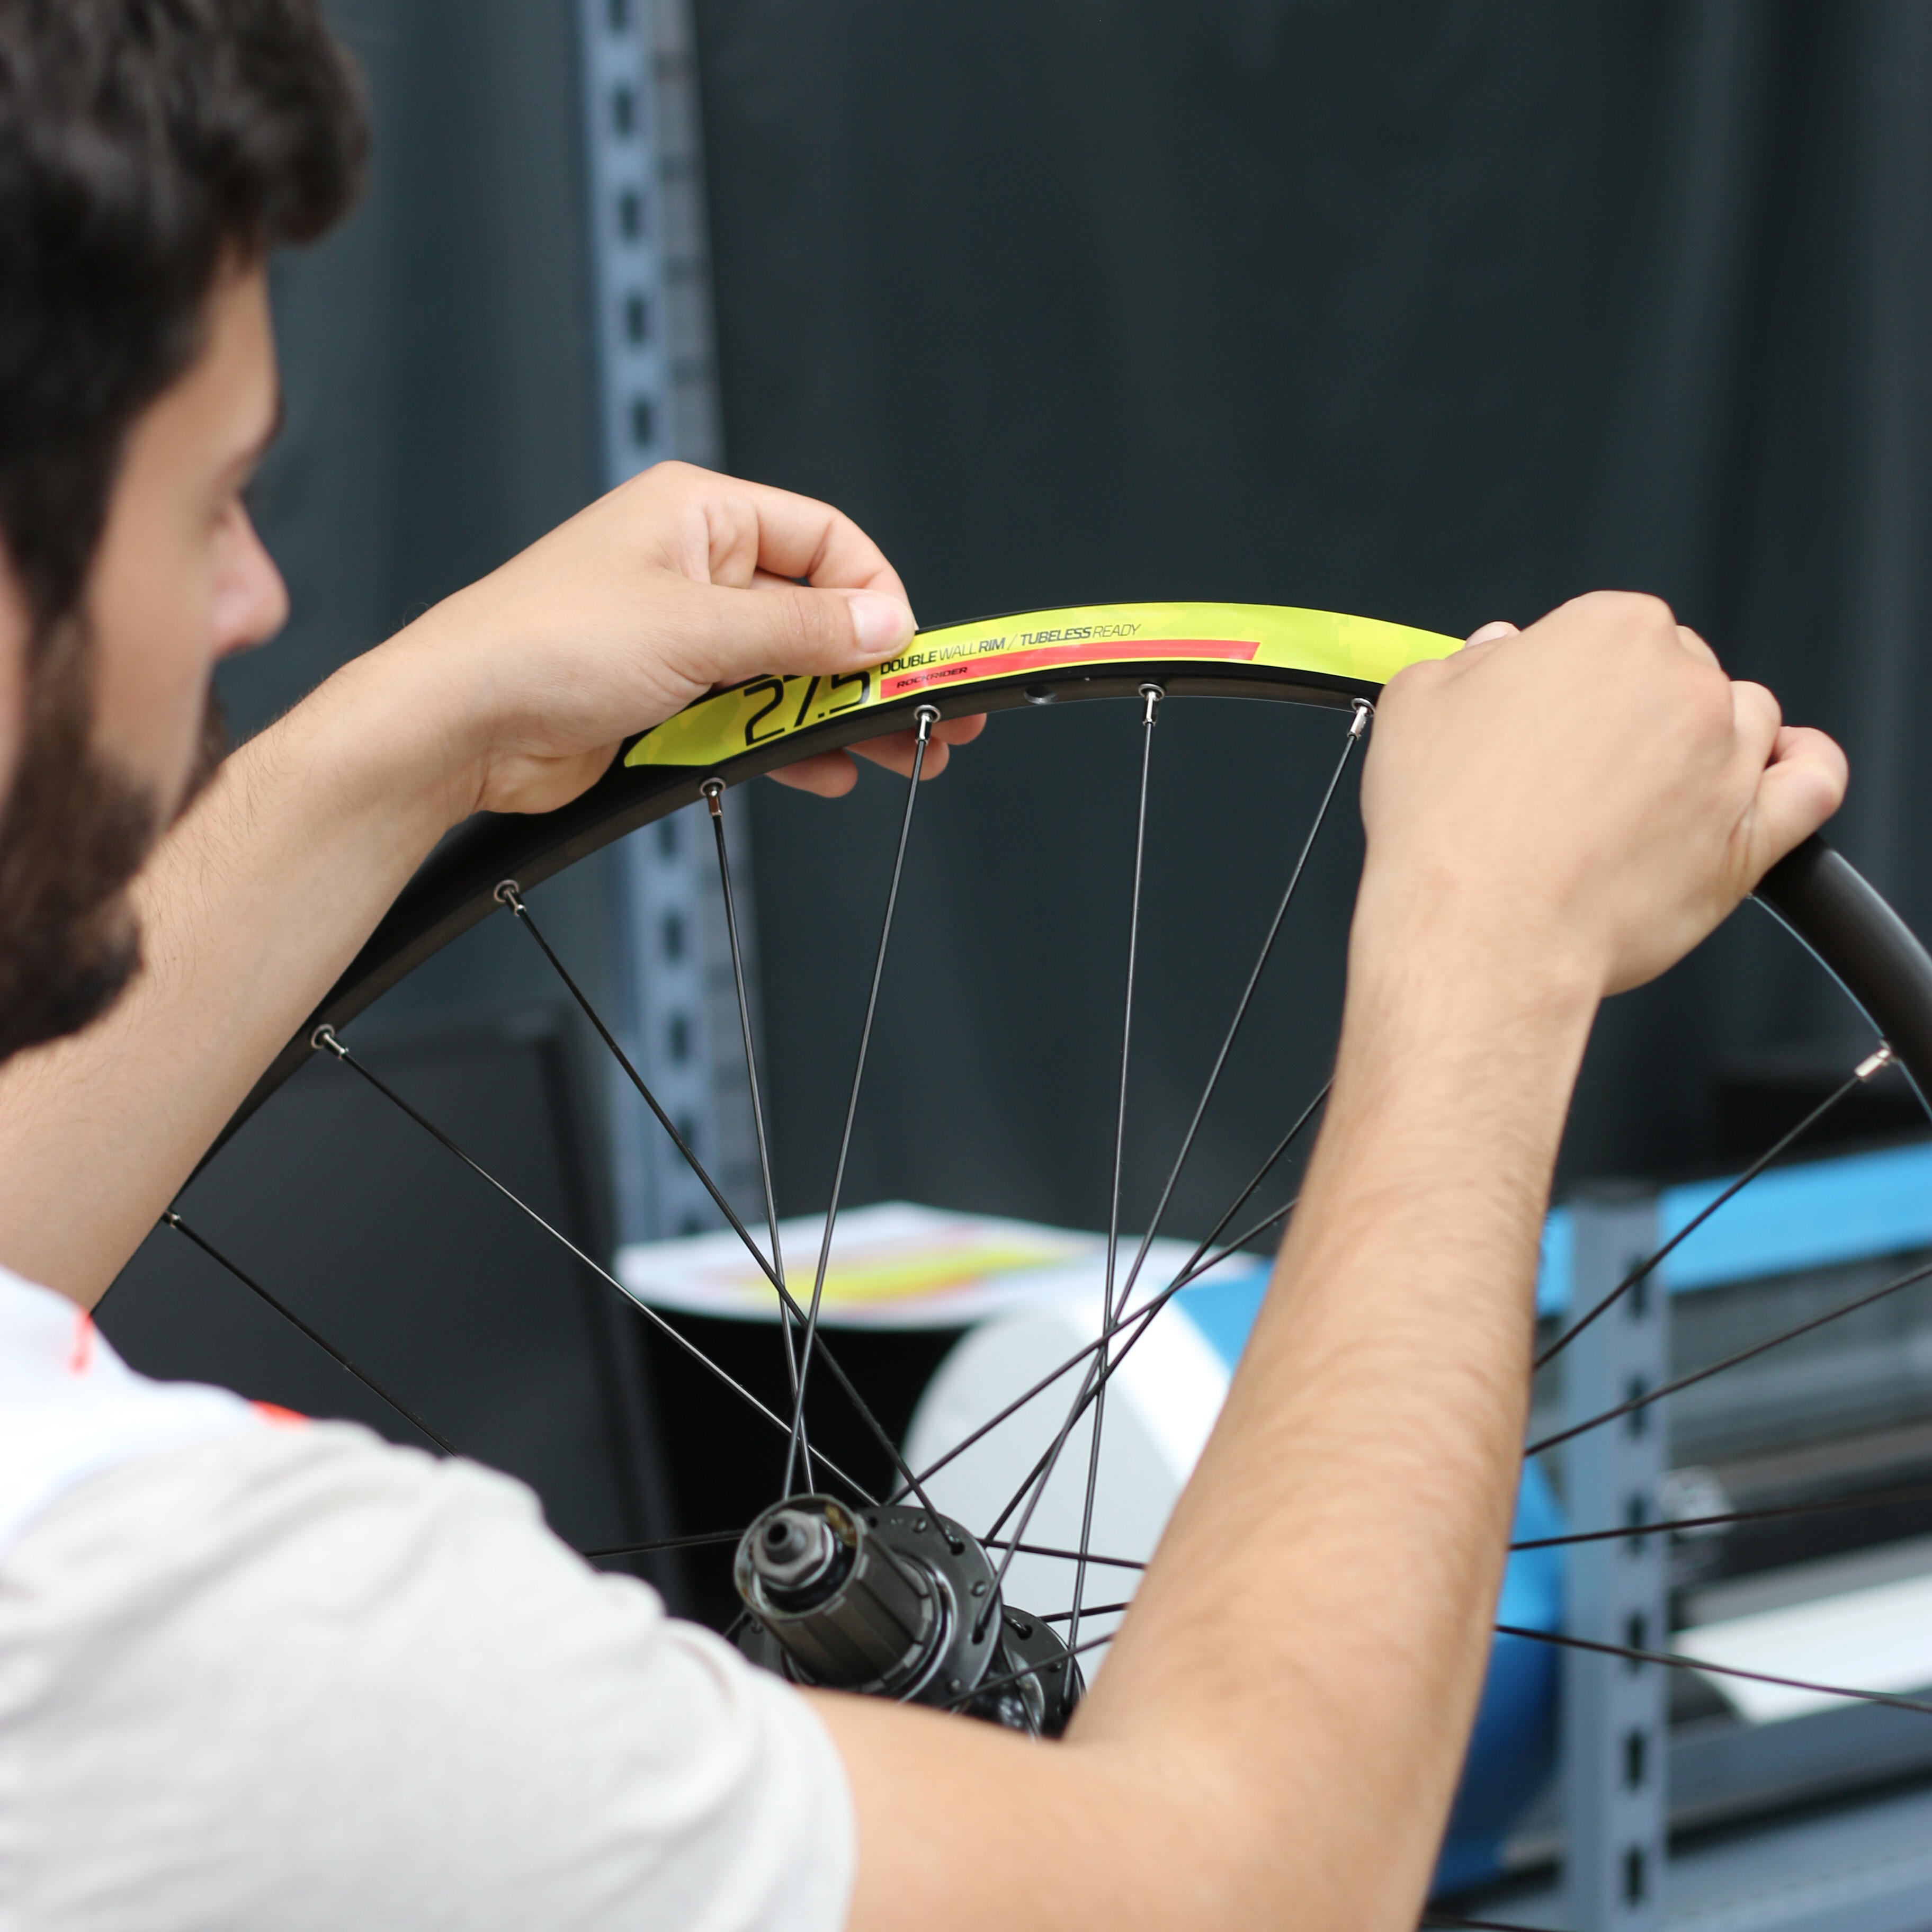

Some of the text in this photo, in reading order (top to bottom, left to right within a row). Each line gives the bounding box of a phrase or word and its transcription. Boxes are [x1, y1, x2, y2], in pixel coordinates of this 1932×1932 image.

[880, 650, 937, 675] DOUBLE
[939, 642, 977, 661] WALL
[979, 637, 1006, 653] RIM
[1021, 627, 1092, 646] TUBELESS
[1092, 623, 1142, 638] READY
[897, 666, 968, 688] ROCKRIDER
[744, 671, 871, 746] 27.5
